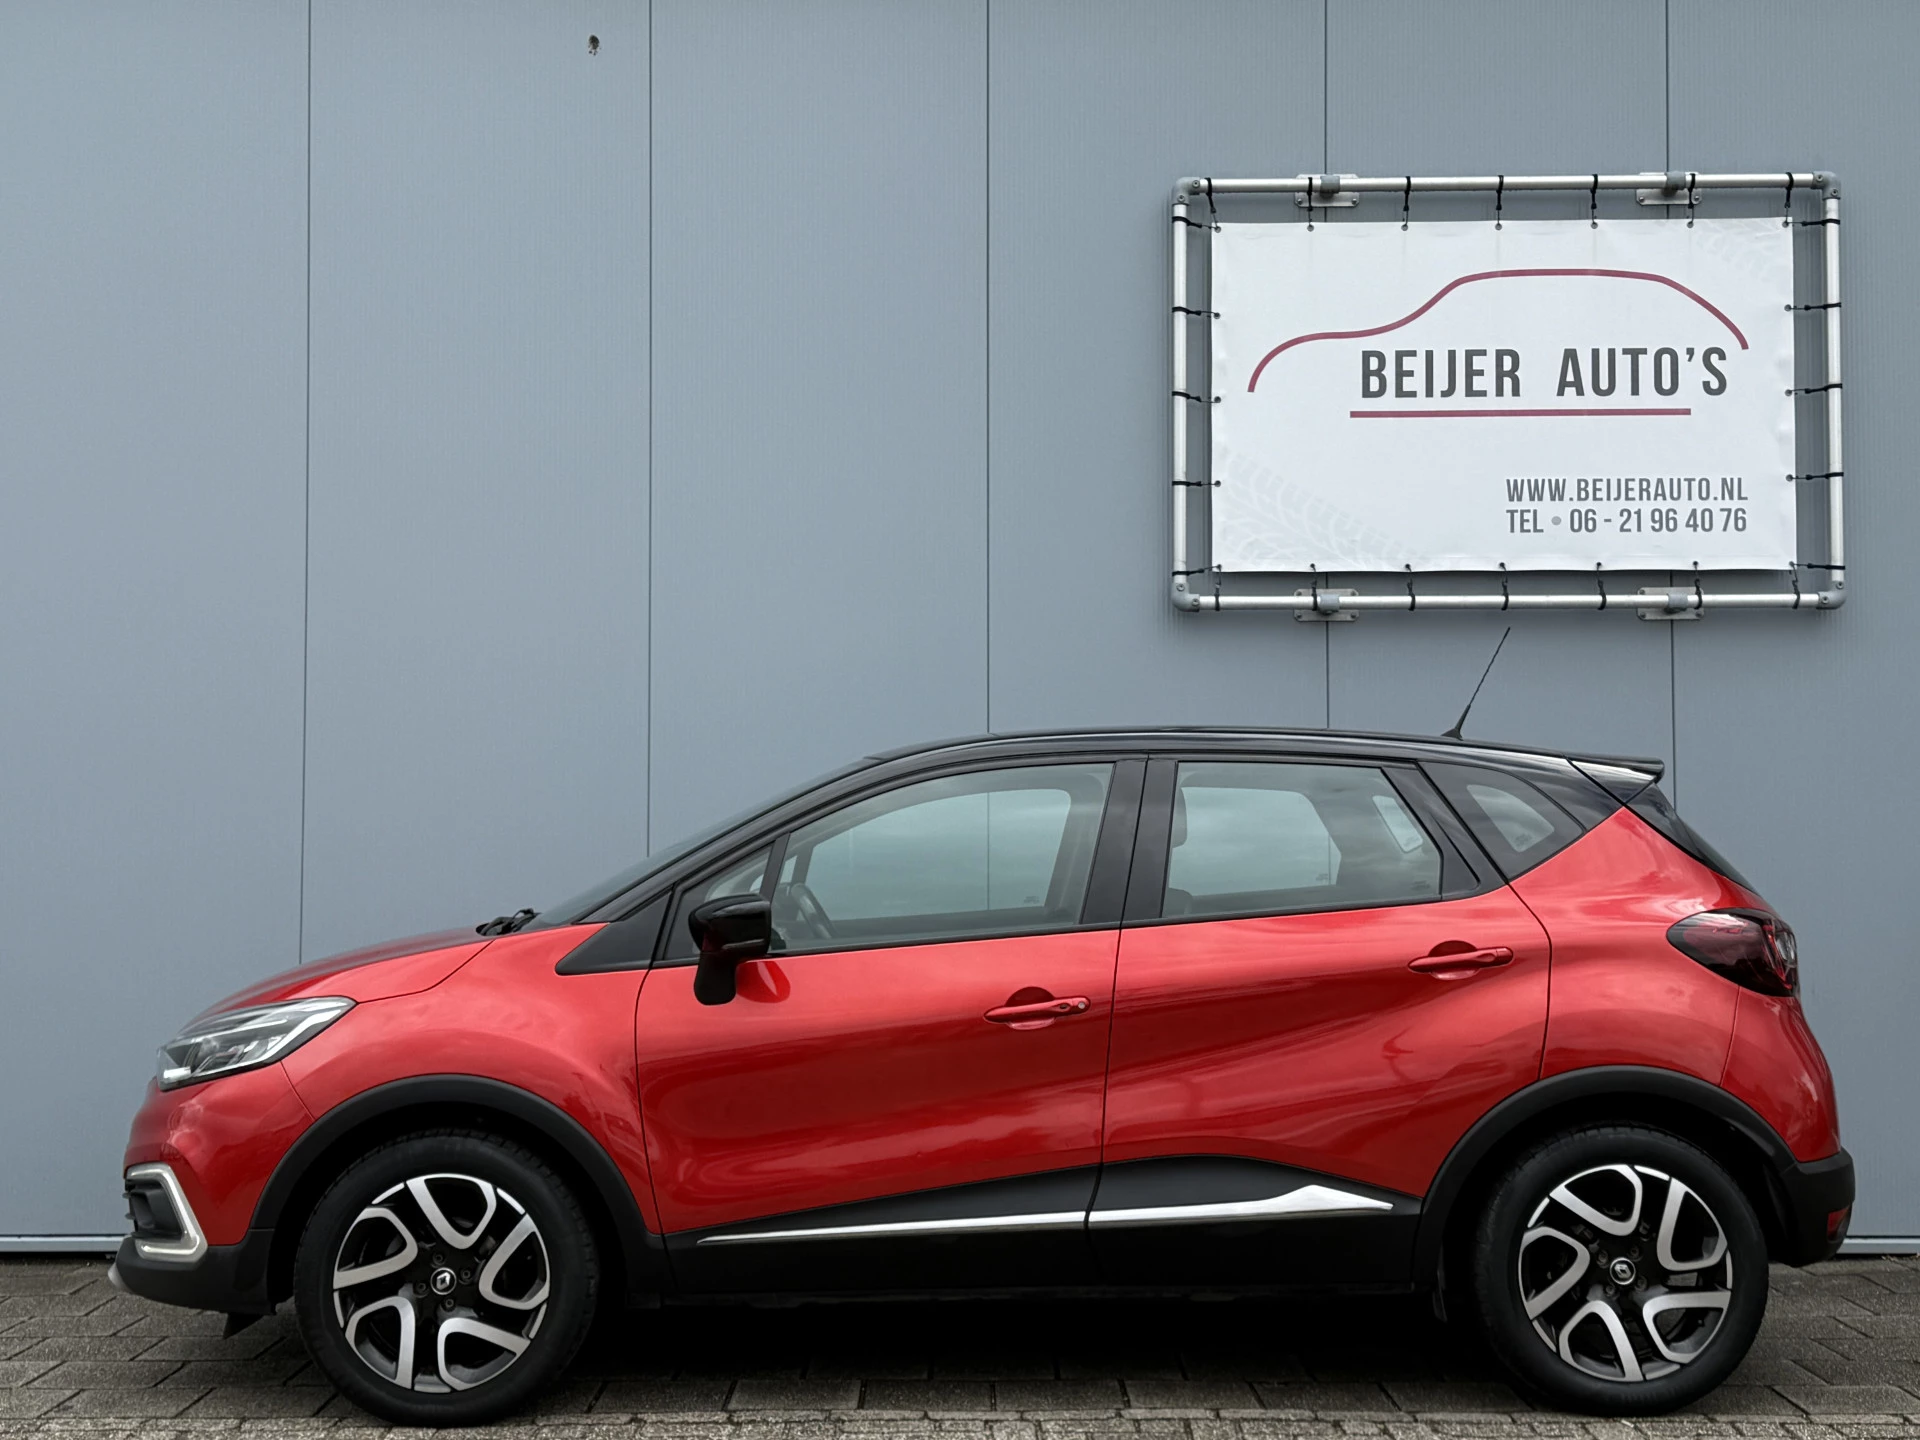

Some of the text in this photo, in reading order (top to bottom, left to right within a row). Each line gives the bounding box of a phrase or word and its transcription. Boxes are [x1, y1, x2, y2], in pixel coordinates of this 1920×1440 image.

[1361, 346, 1728, 399] BEIJER AUTO'S
[1505, 477, 1749, 502] WWW.BEIJERAUTO.NL
[1505, 508, 1544, 533] TEL
[1569, 508, 1597, 533] 06
[1619, 508, 1642, 533] 21
[1650, 507, 1678, 533] 96
[1685, 507, 1714, 532] 40
[1719, 507, 1747, 532] 76
